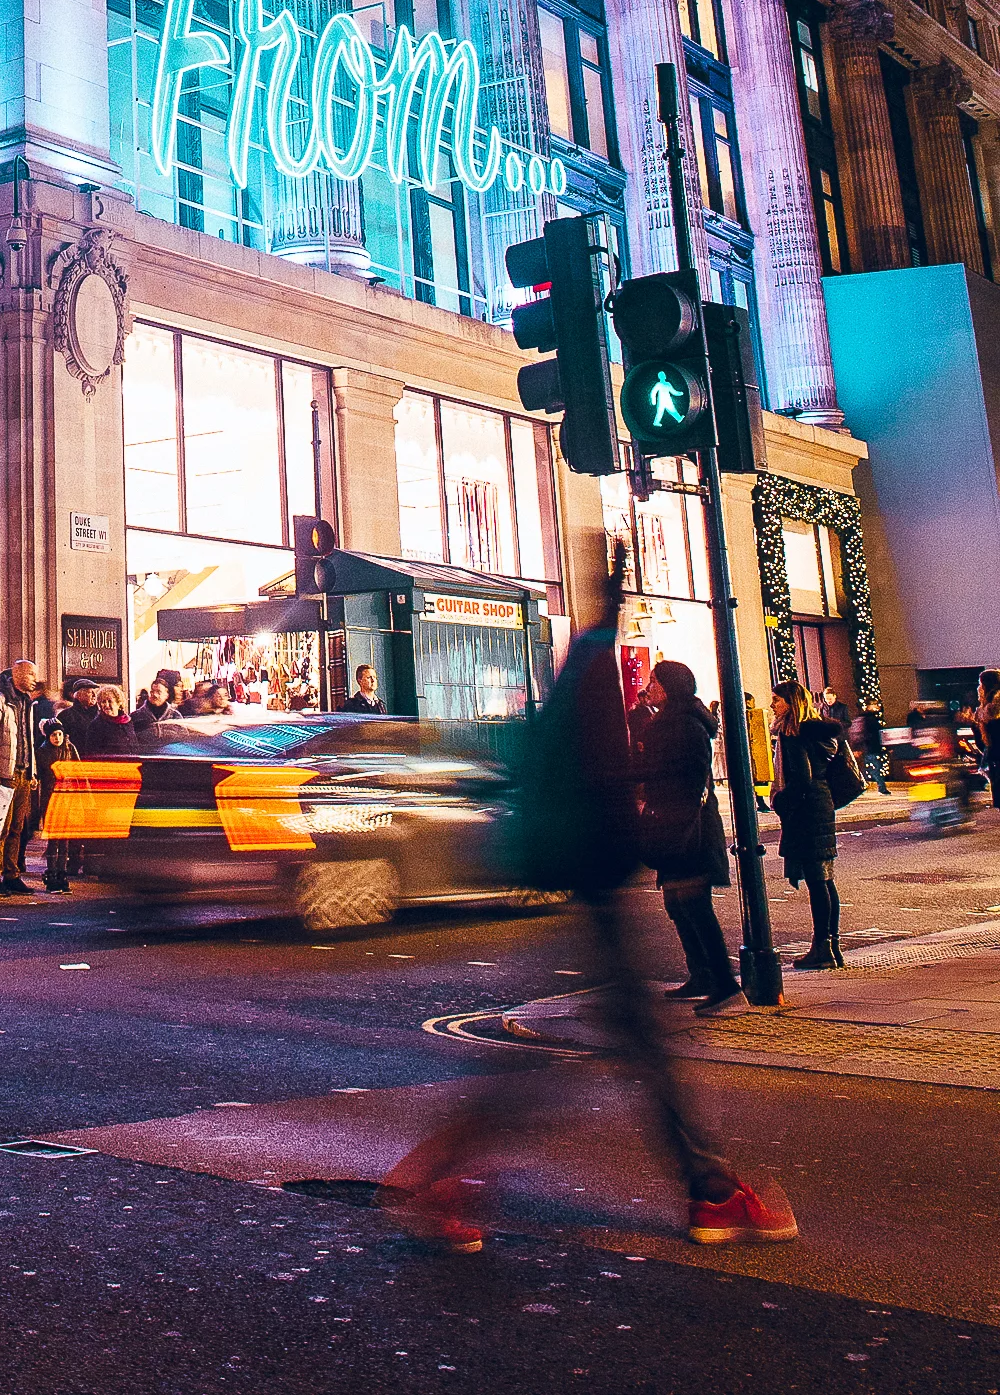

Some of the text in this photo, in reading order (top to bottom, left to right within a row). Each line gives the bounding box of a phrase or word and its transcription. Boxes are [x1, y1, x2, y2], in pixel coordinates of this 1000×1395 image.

[74, 515, 91, 527] DUKE
[75, 527, 107, 540] STREET W1
[436, 598, 514, 618] GUITAR SHOP
[67, 628, 117, 650] SELFRIDGE
